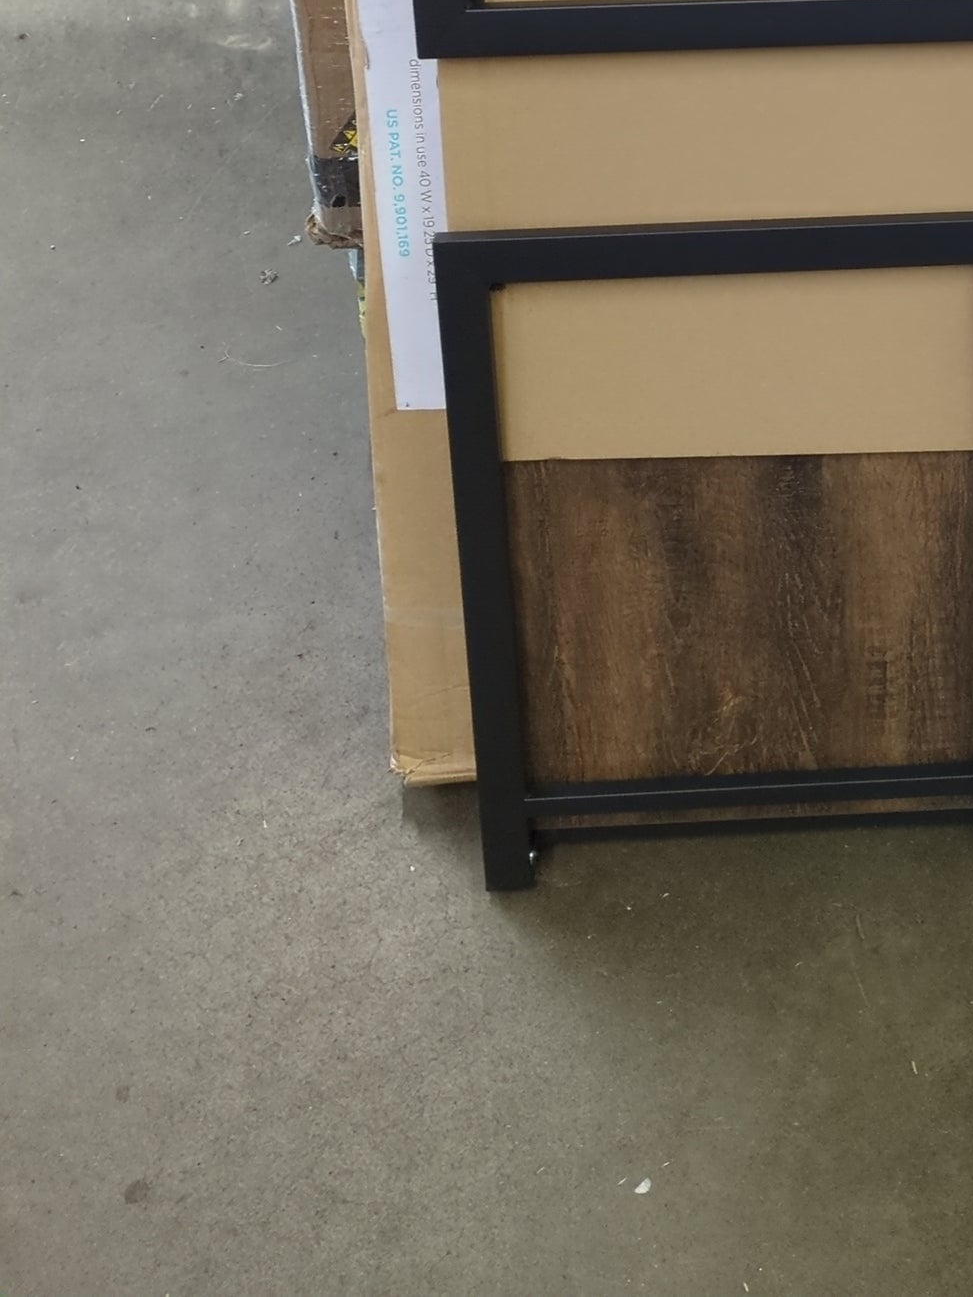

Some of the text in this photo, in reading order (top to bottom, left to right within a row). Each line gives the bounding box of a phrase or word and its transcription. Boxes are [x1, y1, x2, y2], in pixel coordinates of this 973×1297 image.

[409, 59, 424, 129] dimensions
[416, 133, 426, 143] in
[416, 147, 427, 167] use
[387, 110, 410, 256] US PAT. NO. 9,901,169
[419, 171, 431, 187] 40
[421, 190, 432, 202] W
